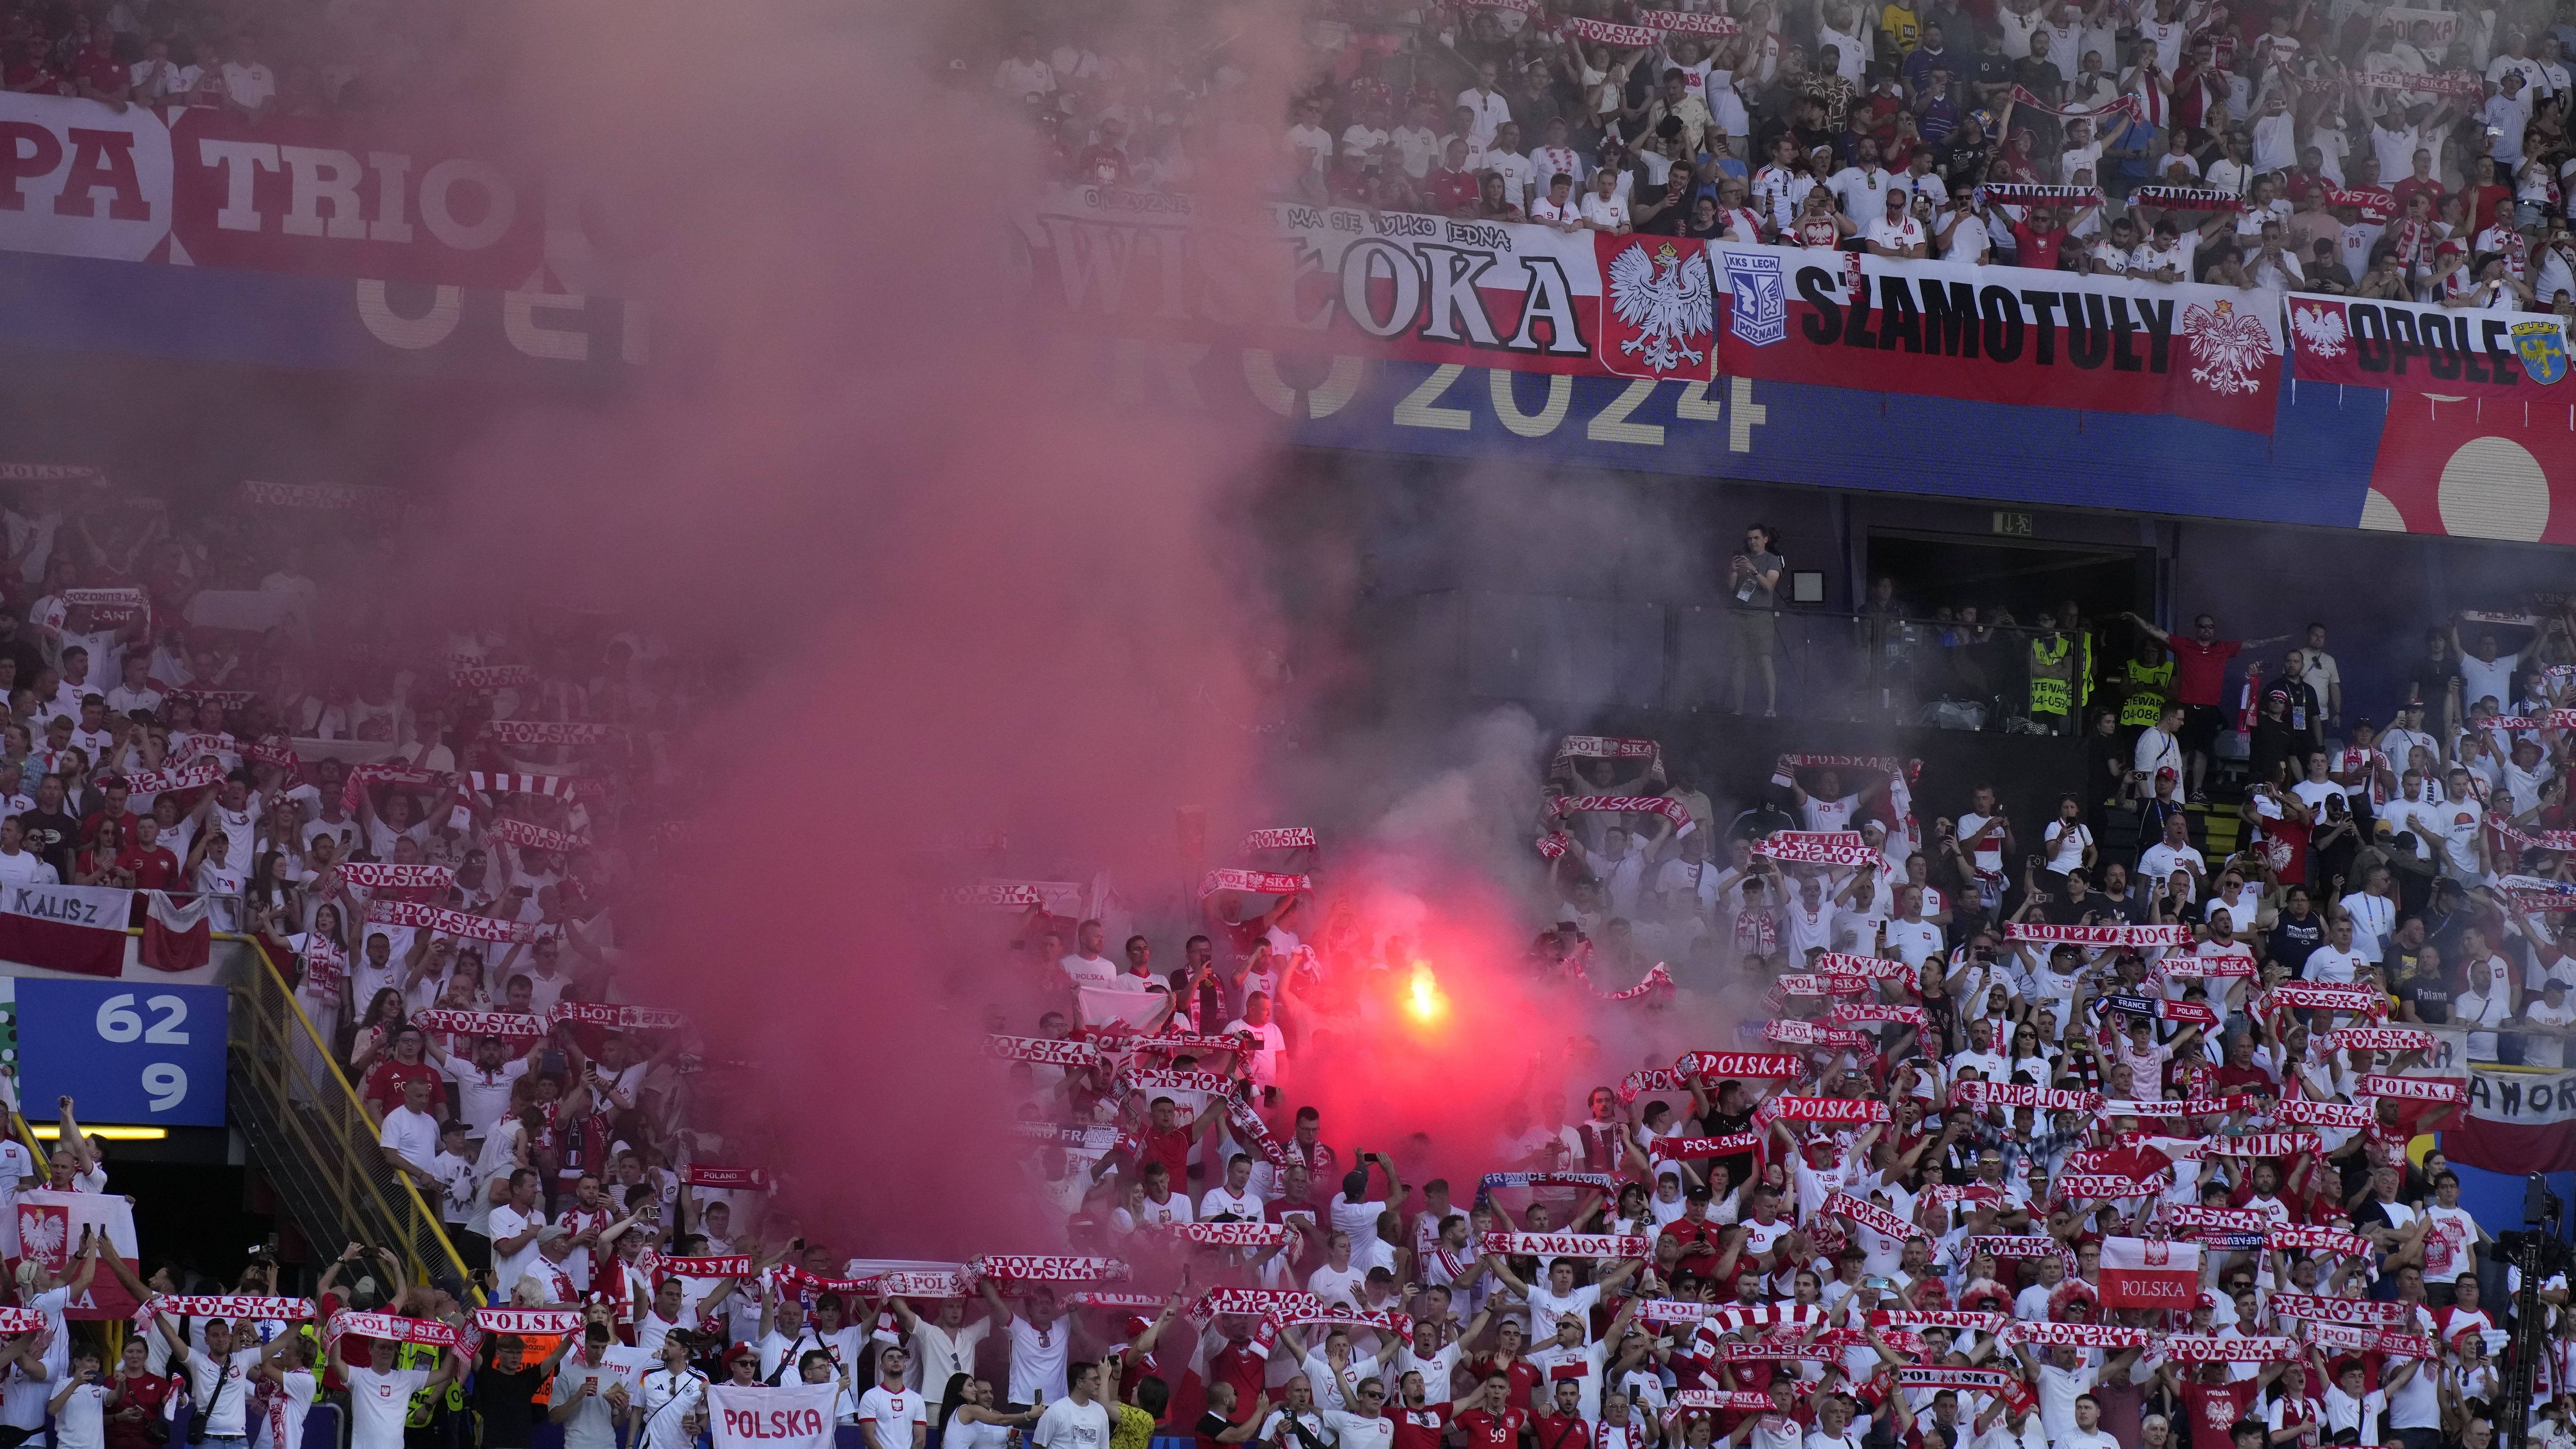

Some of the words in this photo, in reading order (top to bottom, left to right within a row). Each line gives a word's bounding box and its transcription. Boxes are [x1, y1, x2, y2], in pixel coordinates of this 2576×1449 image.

[1576, 19, 1652, 45] POLSKA
[1648, 11, 1729, 33] POLSKA
[1903, 27, 1914, 36] 1&1
[2386, 19, 2454, 42] POLKA
[1981, 63, 1990, 72] 10
[1985, 183, 2096, 205] SZAMOTUŁY
[2140, 187, 2243, 210] SZAMOTUŁY
[2328, 190, 2398, 212] POLSKA
[1287, 209, 1323, 230] MA
[1331, 211, 1363, 234] SIĘ
[2348, 237, 2360, 248] 08
[1729, 257, 1747, 267] KKS
[1752, 259, 1776, 269] LECH
[1739, 320, 1780, 339] POZNAŃ
[1795, 266, 2174, 374] SZAMOTUŁY
[2347, 302, 2518, 385] OPOLE
[1393, 355, 1766, 453] 2024
[2123, 695, 2161, 707] STEWAR
[2123, 709, 2159, 721] 04-086
[500, 723, 598, 744] POLSKA
[253, 745, 292, 761] SKA
[1568, 741, 1600, 752] POL
[1621, 743, 1652, 754] SKA
[1252, 827, 1316, 848] POLSKA
[347, 863, 445, 888] POLSKA
[1265, 877, 1295, 887] SKA
[13, 888, 98, 924] KALISZ
[399, 902, 508, 942] POLSKA
[2287, 925, 2301, 933] PENN
[2302, 926, 2318, 934] STATE
[2169, 959, 2200, 971] POL
[2220, 960, 2249, 971] SKA
[1075, 973, 1105, 981] POLSKA
[1786, 979, 1815, 990] POL
[1833, 979, 1866, 989] SKA
[2310, 980, 2373, 994] POLSKA
[2118, 998, 2147, 1011] FRANCE
[2280, 988, 2370, 1009] POLSKA
[2417, 988, 2447, 1001] Poland
[96, 993, 190, 1045] 62
[2176, 1006, 2204, 1017] POLAND
[435, 1011, 542, 1035] POLSKA
[1784, 1026, 1812, 1040] POL
[1828, 1032, 1856, 1042] SKA
[2339, 1029, 2422, 1050] POLSKA
[982, 1033, 1084, 1065] POLSKA
[1703, 1053, 1786, 1076] POLSKA
[141, 1062, 188, 1113] 9
[1132, 1068, 1232, 1095] POLSKA
[2372, 1079, 2451, 1099] POLSKA
[1789, 1099, 1869, 1119] POLSKA
[2279, 1100, 2372, 1127] POLSKA
[1061, 1130, 1126, 1144] FRANCE
[2230, 1134, 2319, 1157] POLSKA
[703, 1171, 737, 1180] POLAND
[2018, 1157, 2030, 1179] 9
[1484, 1173, 1547, 1184] FRANCE
[1556, 1174, 1612, 1186] POLOGN
[2064, 1176, 2165, 1197] POLSKA
[1841, 1194, 1907, 1243] POLSKA
[2171, 1206, 2263, 1230] OLSKA
[1170, 1223, 1273, 1245] POLSKA
[2270, 1230, 2354, 1251] POLSKA
[662, 1255, 750, 1274] POLSKA
[994, 1257, 1096, 1280] POLSKA
[912, 1277, 947, 1290] POL
[2122, 1280, 2185, 1297] POLSKA
[176, 1296, 293, 1318] POLSKA
[1277, 1308, 1391, 1324] POLSKA
[1658, 1303, 1701, 1317] POL
[349, 1317, 389, 1331] POL
[413, 1325, 455, 1340] SKA
[480, 1311, 581, 1332] POLSKA
[1734, 1344, 1831, 1357] POLSKA
[2177, 1341, 2273, 1360] POLSKA
[2325, 1330, 2359, 1343] POL
[2381, 1338, 2418, 1351] SKA
[1901, 1370, 1935, 1382] POL
[1961, 1373, 2001, 1384] SKA
[1327, 1383, 1333, 1396] 7
[1681, 1390, 1712, 1400] POL
[1733, 1394, 1767, 1405] SKA
[723, 1407, 822, 1439] POLSKA
[1490, 1428, 1505, 1442] 99
